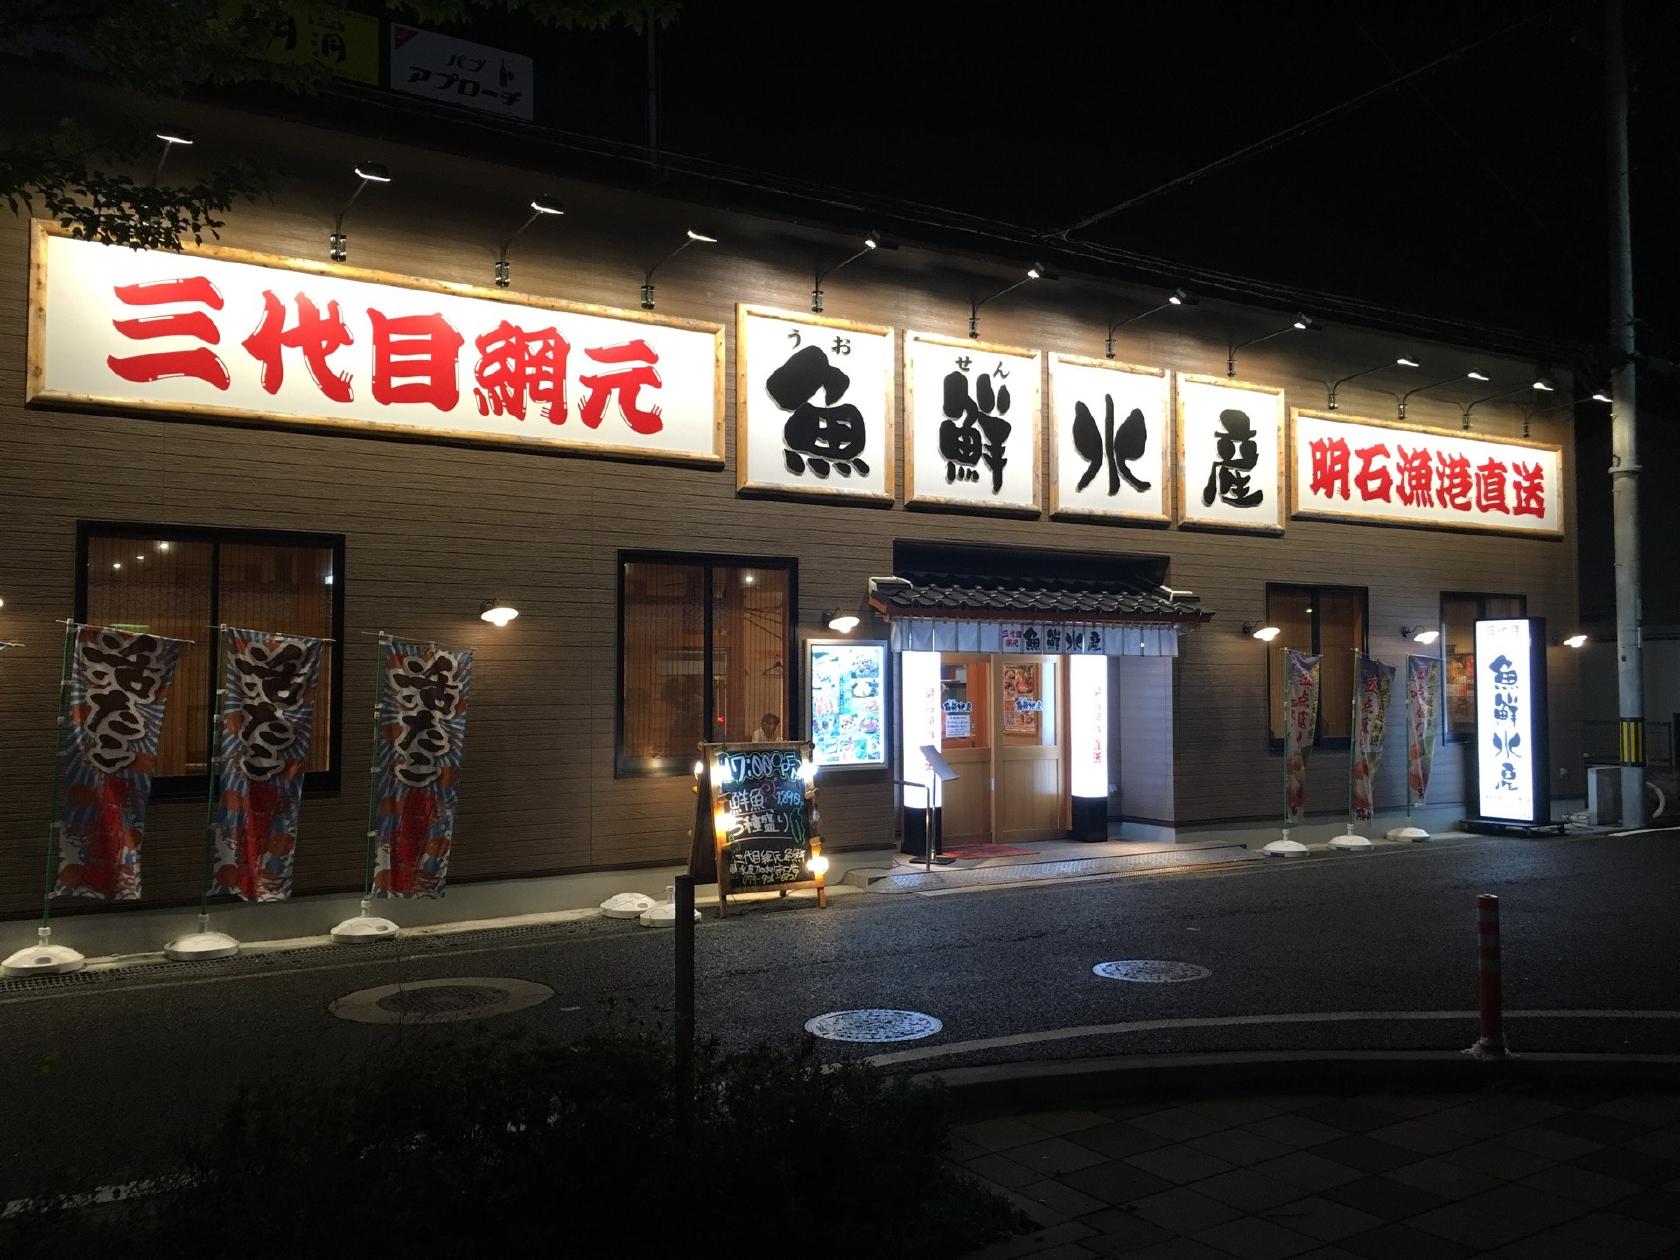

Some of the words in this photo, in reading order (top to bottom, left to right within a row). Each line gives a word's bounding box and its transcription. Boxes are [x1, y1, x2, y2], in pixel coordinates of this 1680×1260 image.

[408, 65, 522, 106] アプローチ
[447, 53, 487, 71] パブ
[107, 275, 663, 435] 三代目網元
[787, 328, 852, 355] うお
[955, 355, 1010, 379] せん
[766, 344, 1264, 507] 魚鮮水産
[1309, 436, 1545, 519] 明石漁港直送
[1023, 627, 1102, 652] 魚鮮水産
[1488, 655, 1522, 791] 魚鮮水産
[729, 788, 766, 815] 鮮魚
